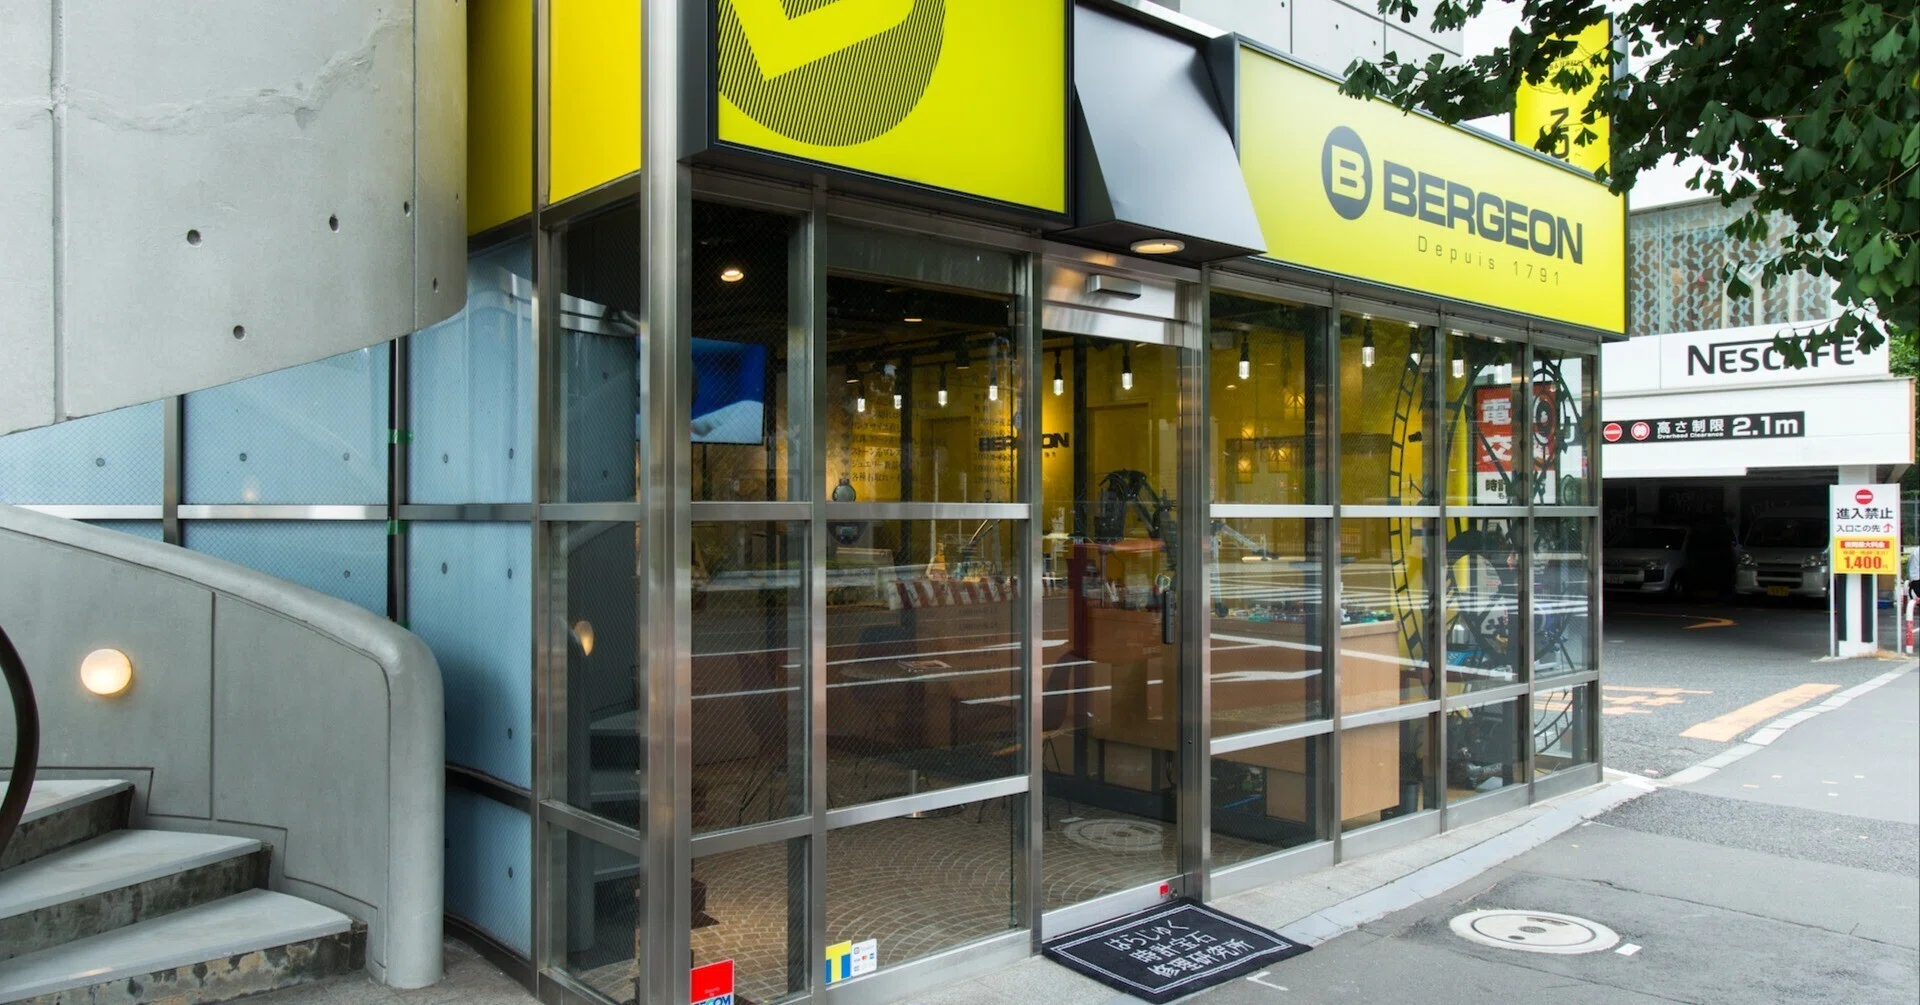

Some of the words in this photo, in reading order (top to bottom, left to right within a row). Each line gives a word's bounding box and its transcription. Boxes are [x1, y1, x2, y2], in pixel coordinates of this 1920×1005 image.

[1383, 160, 1583, 265] BERGEON
[1418, 235, 1495, 270] Depuis
[1512, 260, 1560, 286] 1791
[1656, 418, 1725, 435] 高さ制限
[1732, 415, 1799, 437] 2.1m
[1657, 432, 1689, 440] Overhead
[1836, 507, 1894, 520] 進入禁止
[1836, 524, 1880, 533] 入口この先
[1104, 919, 1189, 951] はらじゅく
[1129, 930, 1218, 963] 時計宝石
[1147, 938, 1255, 978] 修理研究所
